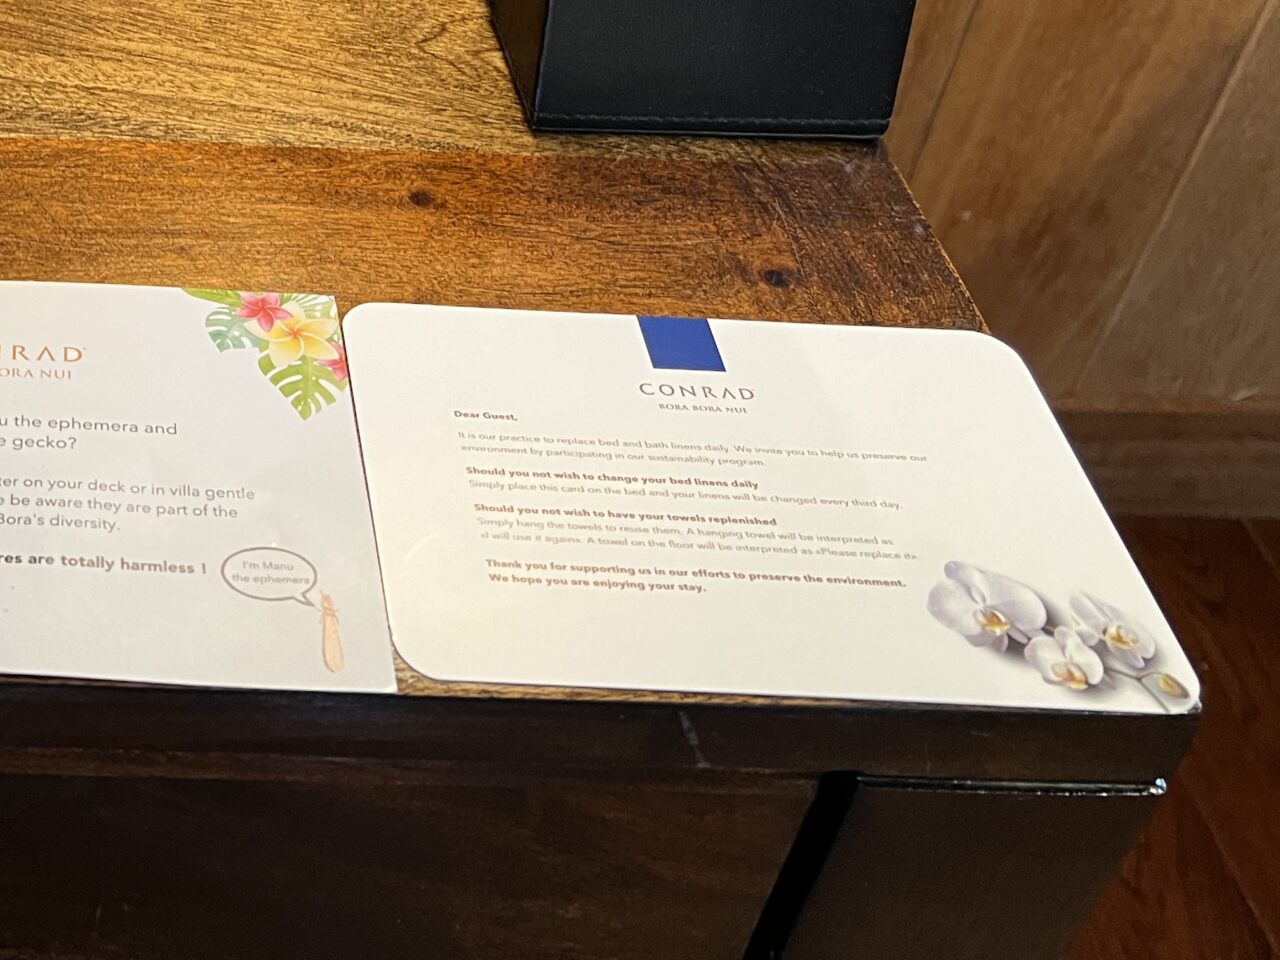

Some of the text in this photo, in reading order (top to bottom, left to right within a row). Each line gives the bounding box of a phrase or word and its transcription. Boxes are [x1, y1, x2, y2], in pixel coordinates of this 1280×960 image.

[40, 369, 71, 380] NUI
[639, 383, 755, 400] CONRAD
[454, 411, 480, 419] Dear
[659, 403, 689, 411] BORA
[14, 415, 41, 428] the
[48, 418, 138, 433] ephemera
[144, 422, 177, 435] and
[12, 436, 77, 450] gecko?
[466, 467, 506, 476] Should
[509, 470, 529, 478] you
[533, 470, 551, 478] not
[554, 472, 580, 480] wish
[597, 474, 638, 484] change
[641, 476, 666, 485] your
[670, 476, 691, 485] bed
[695, 478, 728, 487] linens
[731, 480, 758, 490] daily
[24, 477, 42, 488] on
[48, 479, 83, 490] your
[88, 479, 125, 492] deck
[130, 484, 147, 494] or
[151, 484, 165, 495] in
[169, 485, 200, 497] villa
[206, 488, 255, 501] gentle
[10, 495, 30, 506] be
[35, 498, 83, 508] aware
[88, 497, 121, 514] they
[126, 503, 151, 514] are
[156, 504, 188, 517] part
[192, 504, 208, 516] of
[212, 505, 237, 518] the
[474, 503, 776, 526] Should you not wish to have your towels replenished
[49, 515, 120, 532] diversity.
[28, 554, 54, 565] are
[61, 554, 114, 572] totally
[121, 557, 194, 574] harmless
[243, 561, 294, 571] I'm Manu
[486, 559, 906, 587] Thank you for supporting us in our efforts to preserve the environment.
[232, 574, 310, 585] the ephemera
[489, 573, 706, 593] We hope you are enjoying your stay.
